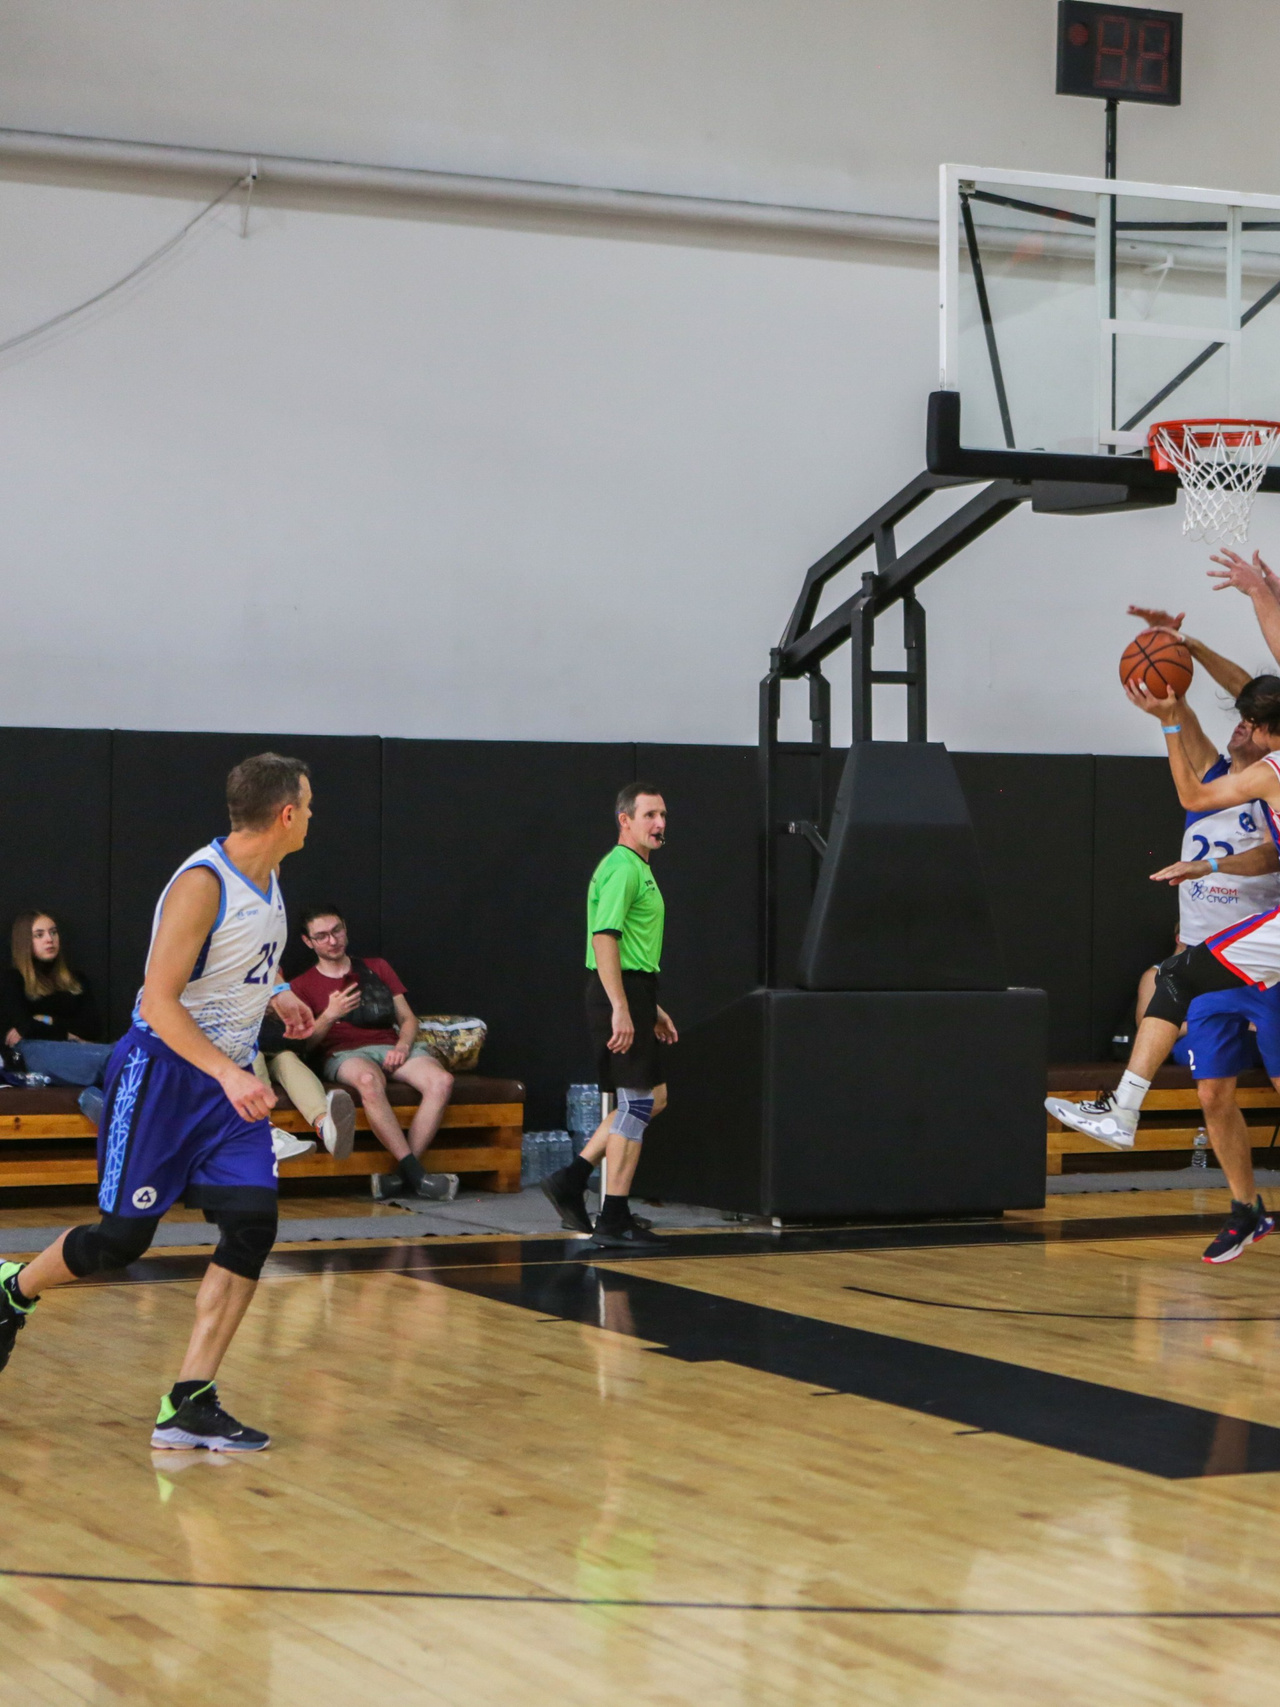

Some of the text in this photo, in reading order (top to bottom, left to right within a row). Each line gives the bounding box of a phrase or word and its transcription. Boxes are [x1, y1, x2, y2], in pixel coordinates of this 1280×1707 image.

[1209, 886, 1238, 896] АТОМ
[1206, 895, 1240, 904] СПОРТ
[243, 941, 278, 985] 21
